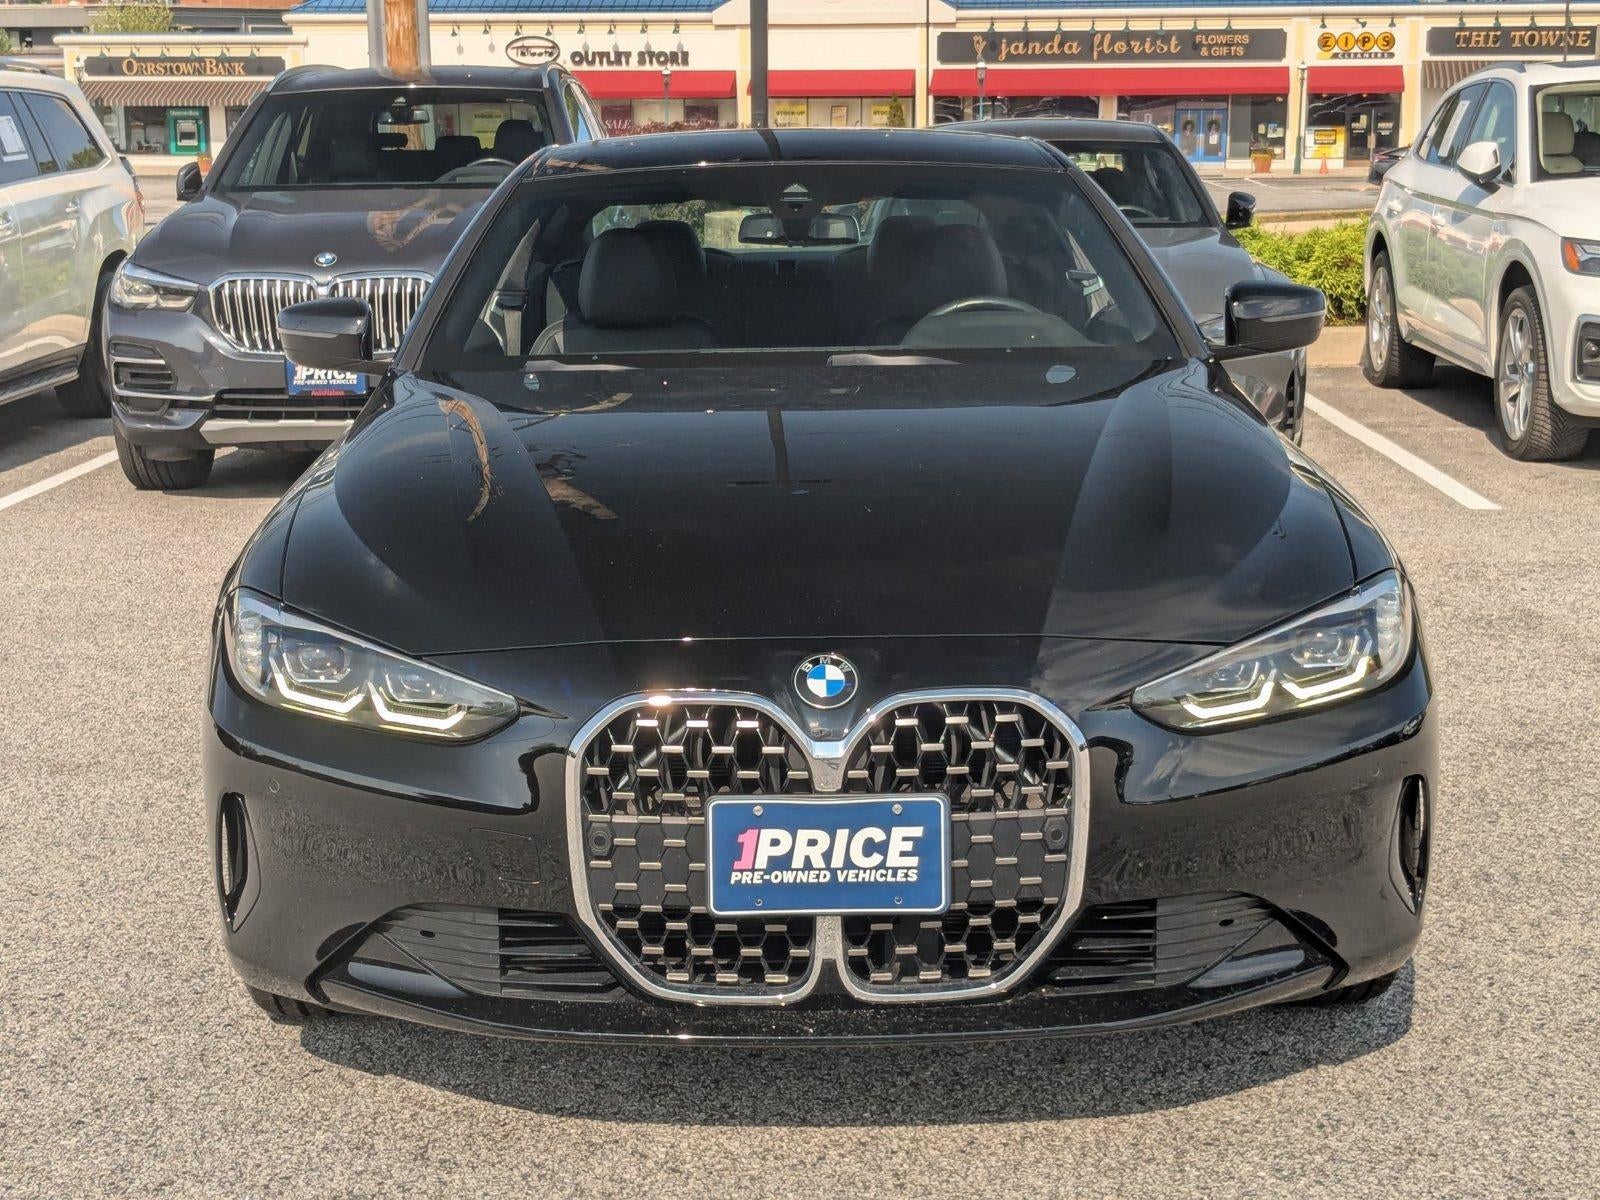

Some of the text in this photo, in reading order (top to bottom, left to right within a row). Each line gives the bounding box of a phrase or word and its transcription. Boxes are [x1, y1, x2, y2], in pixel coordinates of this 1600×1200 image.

[1195, 34, 1249, 44] FLOWERS
[1320, 33, 1392, 49] ZIPS
[1455, 30, 1590, 48] THE TOWNE
[998, 34, 1181, 62] janda florist
[1200, 46, 1244, 57] & GIFTS
[570, 51, 689, 66] OUTLET STORE
[605, 119, 631, 129] SALE
[800, 656, 852, 672] BMW
[733, 826, 924, 870] 1PRICE
[730, 868, 918, 884] PRE-OWNED VEHICLES
